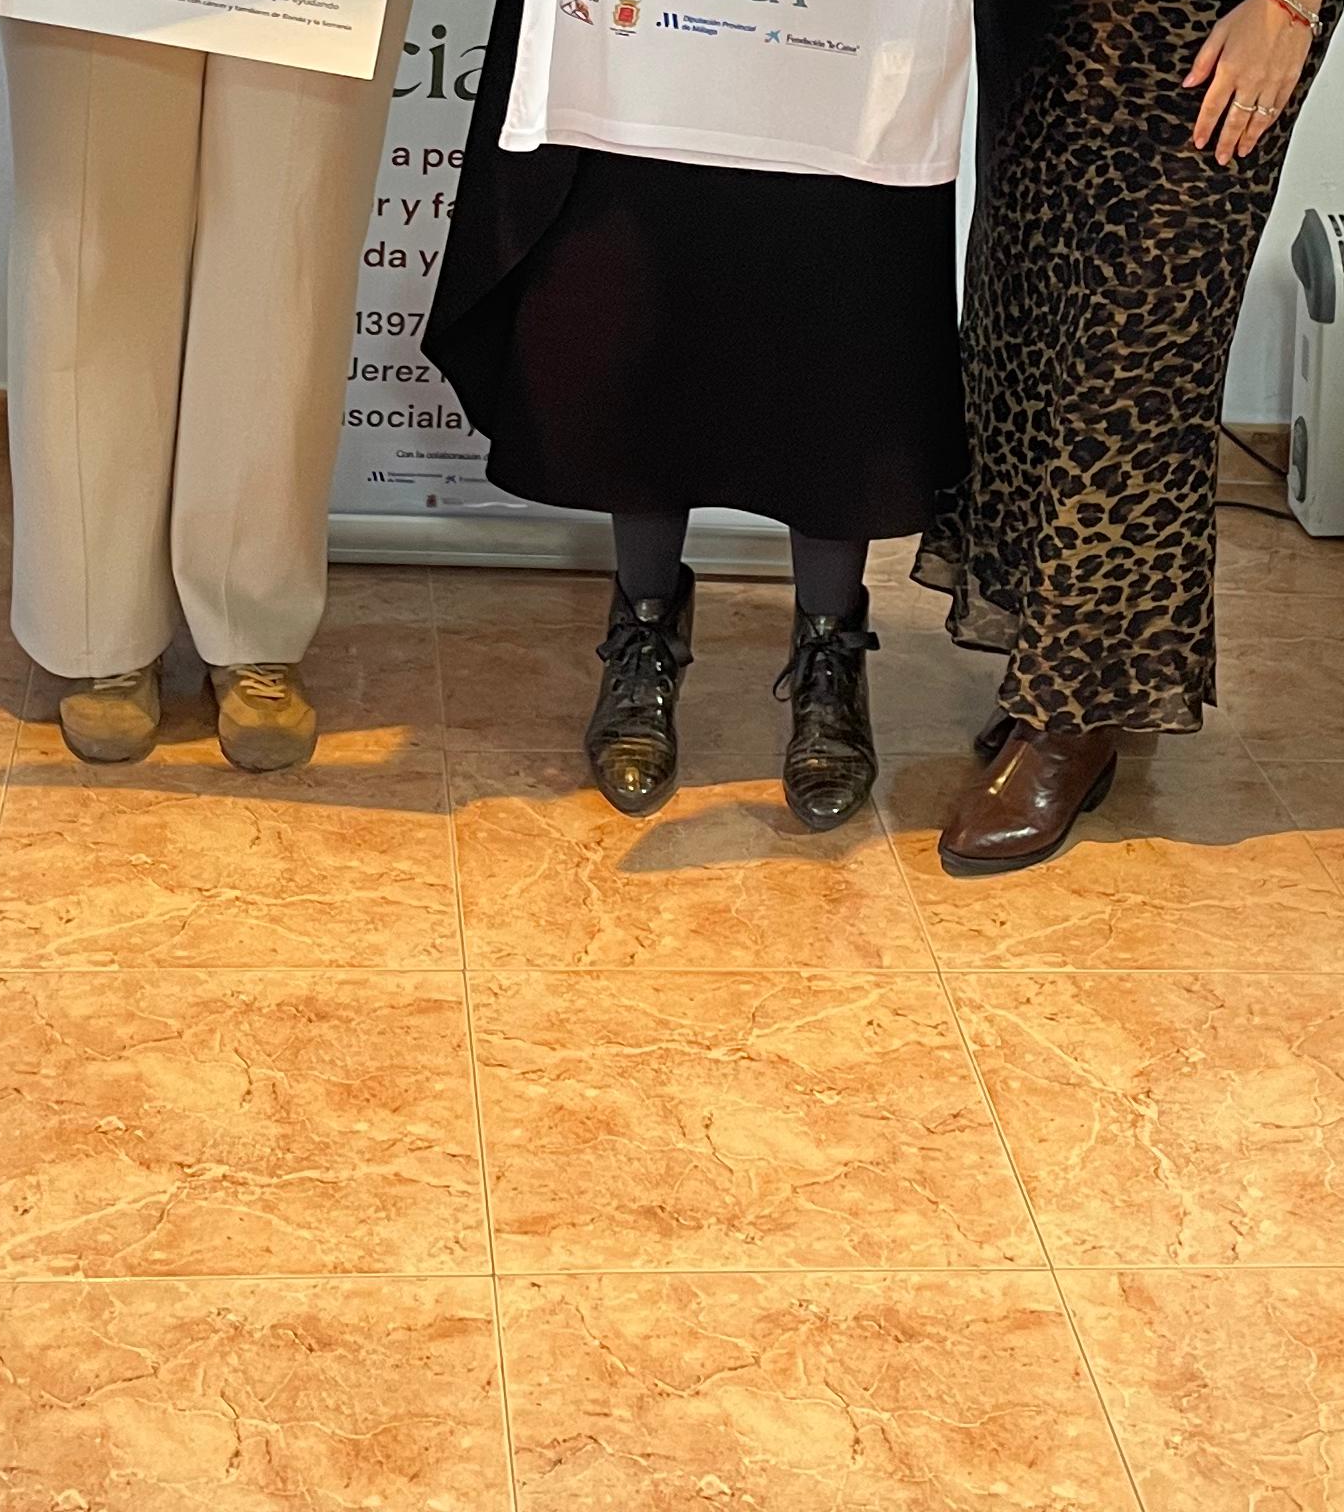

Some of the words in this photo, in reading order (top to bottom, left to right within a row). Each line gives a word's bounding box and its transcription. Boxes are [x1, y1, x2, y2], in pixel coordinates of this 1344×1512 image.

[401, 198, 422, 226] y
[363, 241, 407, 269] da
[418, 249, 440, 277] y
[356, 310, 426, 337] 1397
[347, 356, 432, 384] Jerez
[342, 404, 476, 437] sociala
